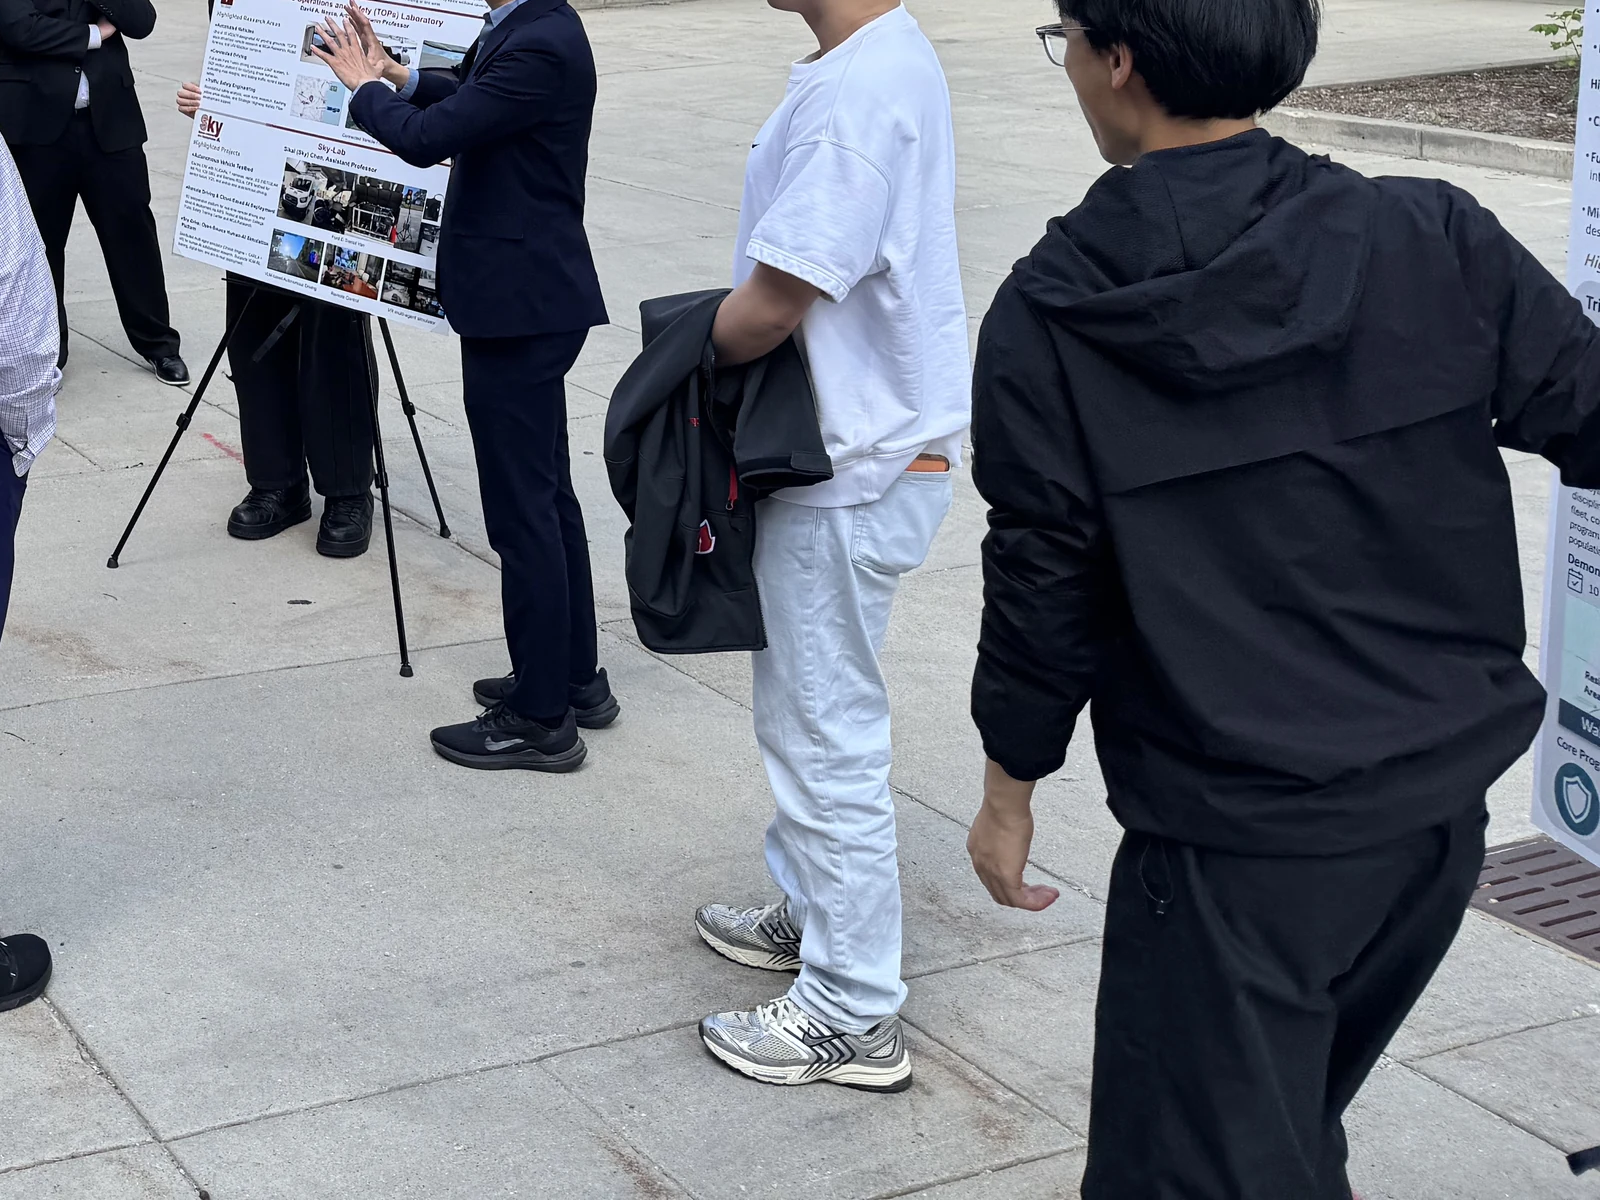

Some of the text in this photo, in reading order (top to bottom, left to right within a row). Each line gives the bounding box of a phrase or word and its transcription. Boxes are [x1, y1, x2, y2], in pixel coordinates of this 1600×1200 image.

[373, 8, 399, 19] (TOPs)
[400, 13, 443, 27] Laboratory
[382, 19, 409, 28] Professor
[198, 114, 223, 137] Sky
[220, 146, 240, 156] Projects
[317, 143, 345, 155] Sky-Lab
[296, 149, 309, 157] (Sky)
[325, 156, 350, 166] Assistant
[350, 162, 377, 172] Professor
[1556, 736, 1577, 756] Core
